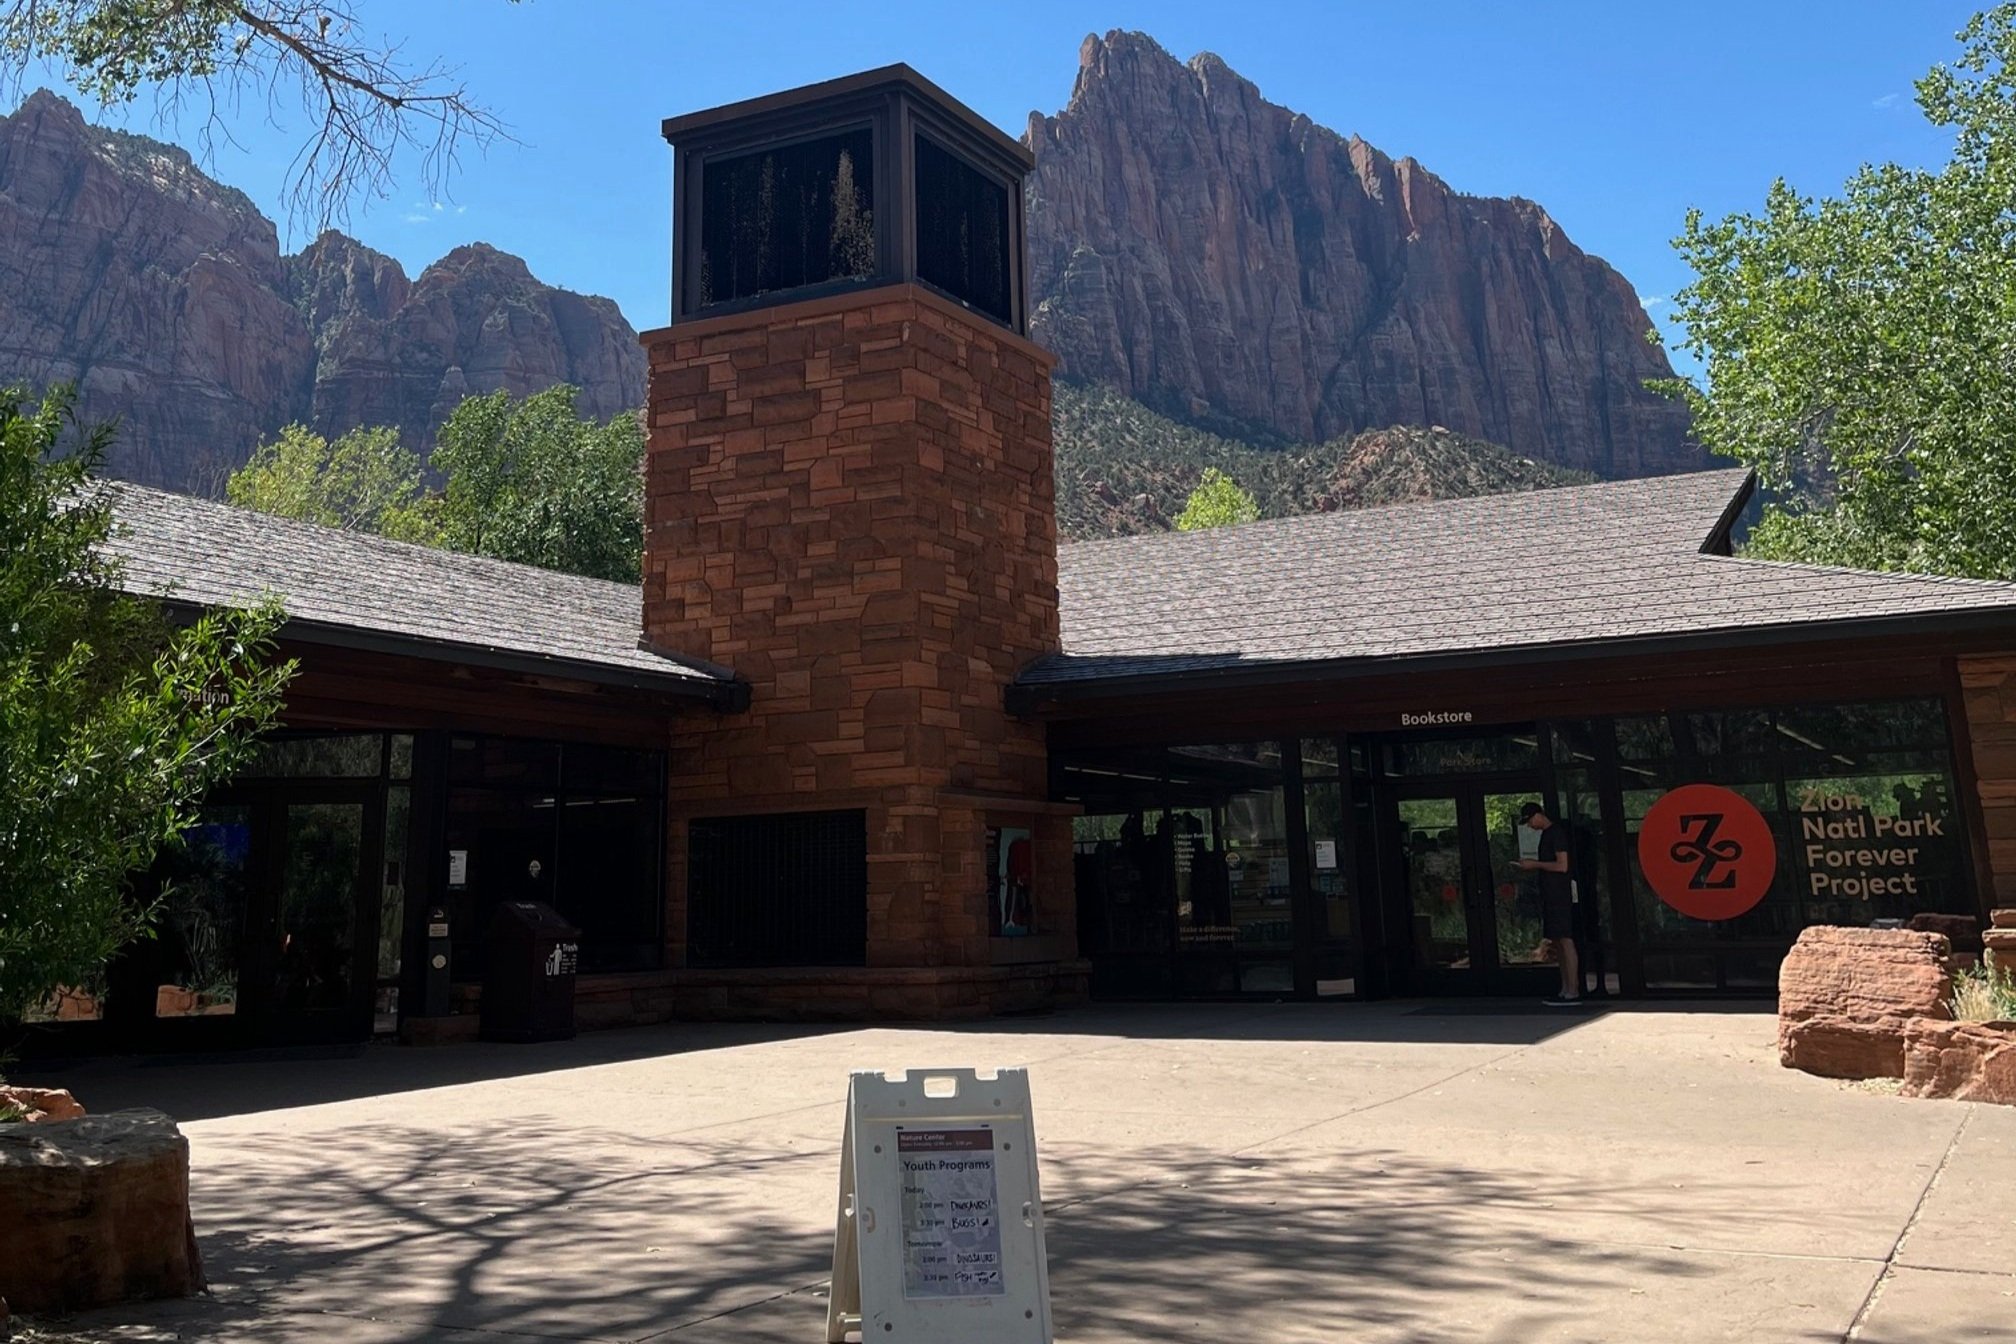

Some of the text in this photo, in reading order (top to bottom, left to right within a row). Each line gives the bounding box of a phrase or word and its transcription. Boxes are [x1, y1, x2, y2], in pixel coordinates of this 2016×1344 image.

[1401, 711, 1472, 726] Bookstore
[1800, 788, 1862, 813] Zion
[1802, 812, 1944, 840] Natl Park
[1806, 845, 1918, 868] Forever
[1810, 871, 1917, 901] Project
[562, 942, 578, 953] Trash
[900, 1134, 946, 1142] Nature Center
[904, 1159, 990, 1173] Youth Programs
[904, 1186, 925, 1195] Today
